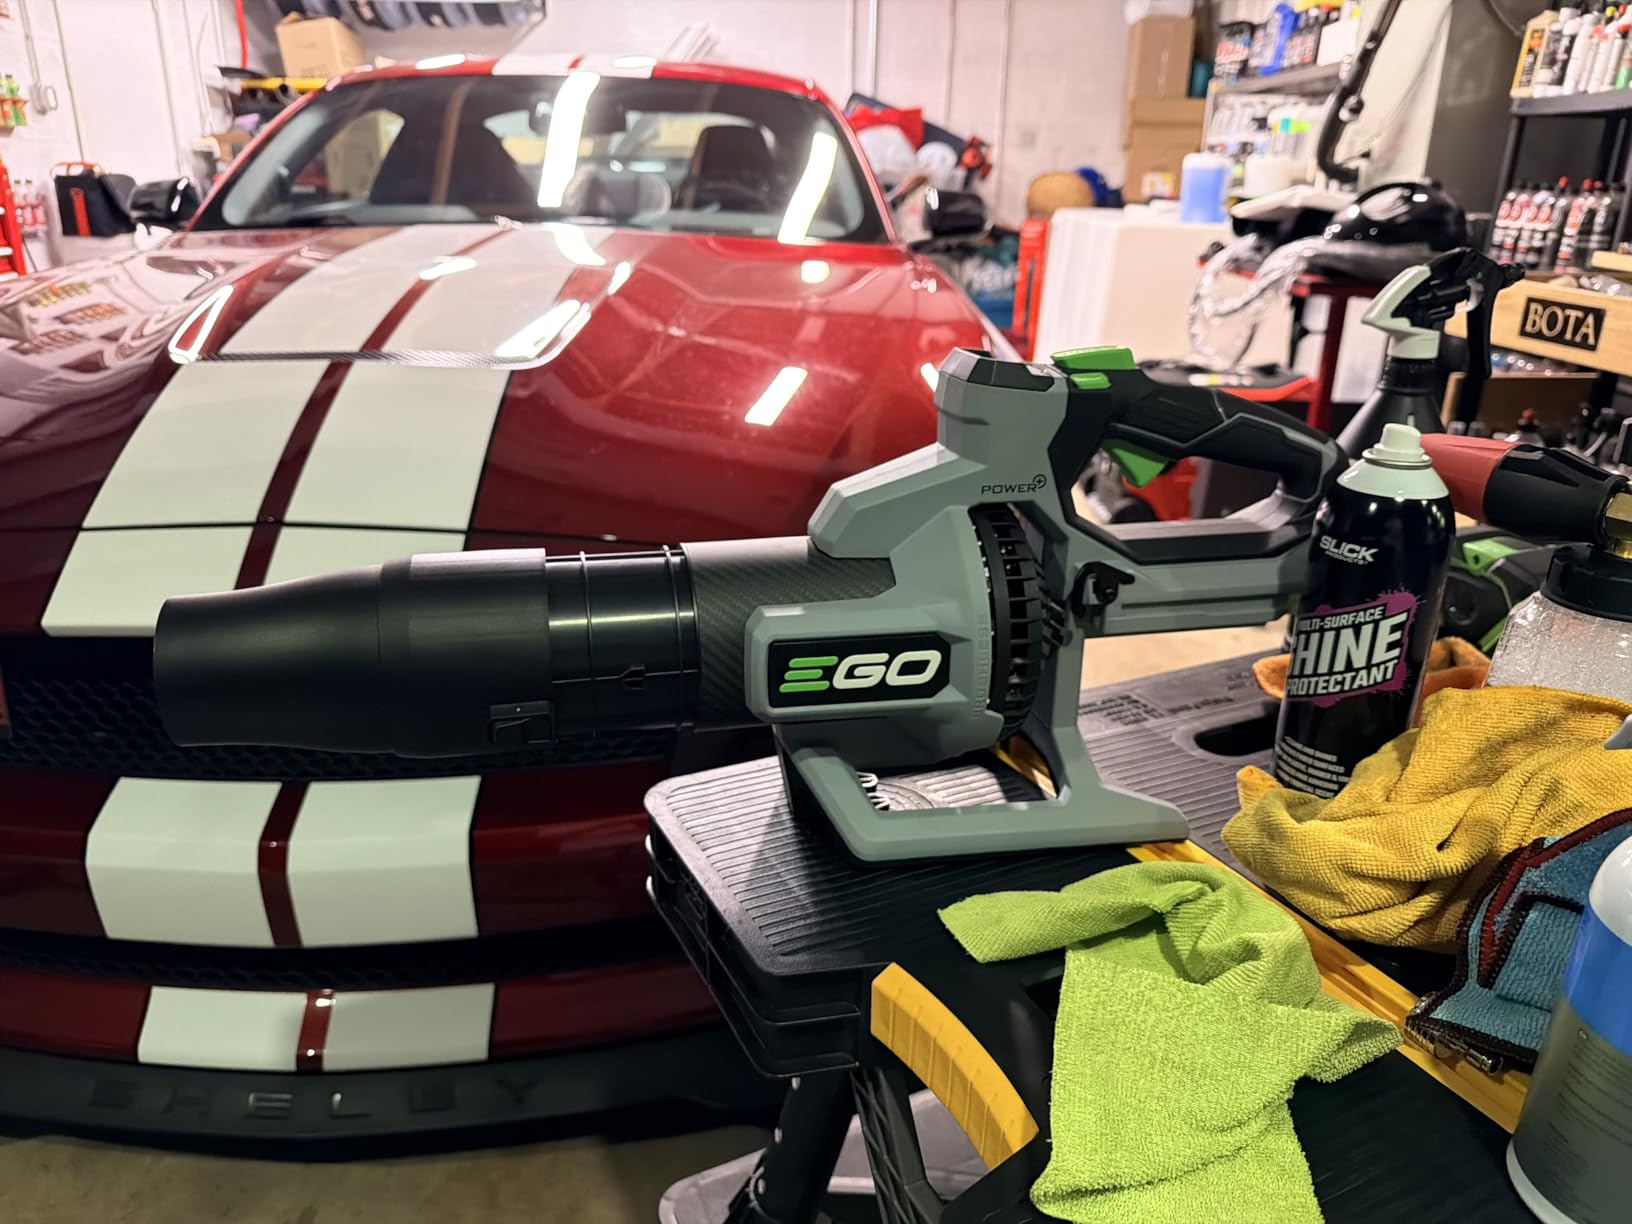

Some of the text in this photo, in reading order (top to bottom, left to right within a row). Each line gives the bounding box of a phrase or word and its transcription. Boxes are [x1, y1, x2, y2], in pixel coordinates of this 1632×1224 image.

[1525, 302, 1596, 346] BOTA
[1320, 535, 1379, 562] SLICK
[1291, 612, 1409, 676] HINE
[779, 650, 942, 693] EGO
